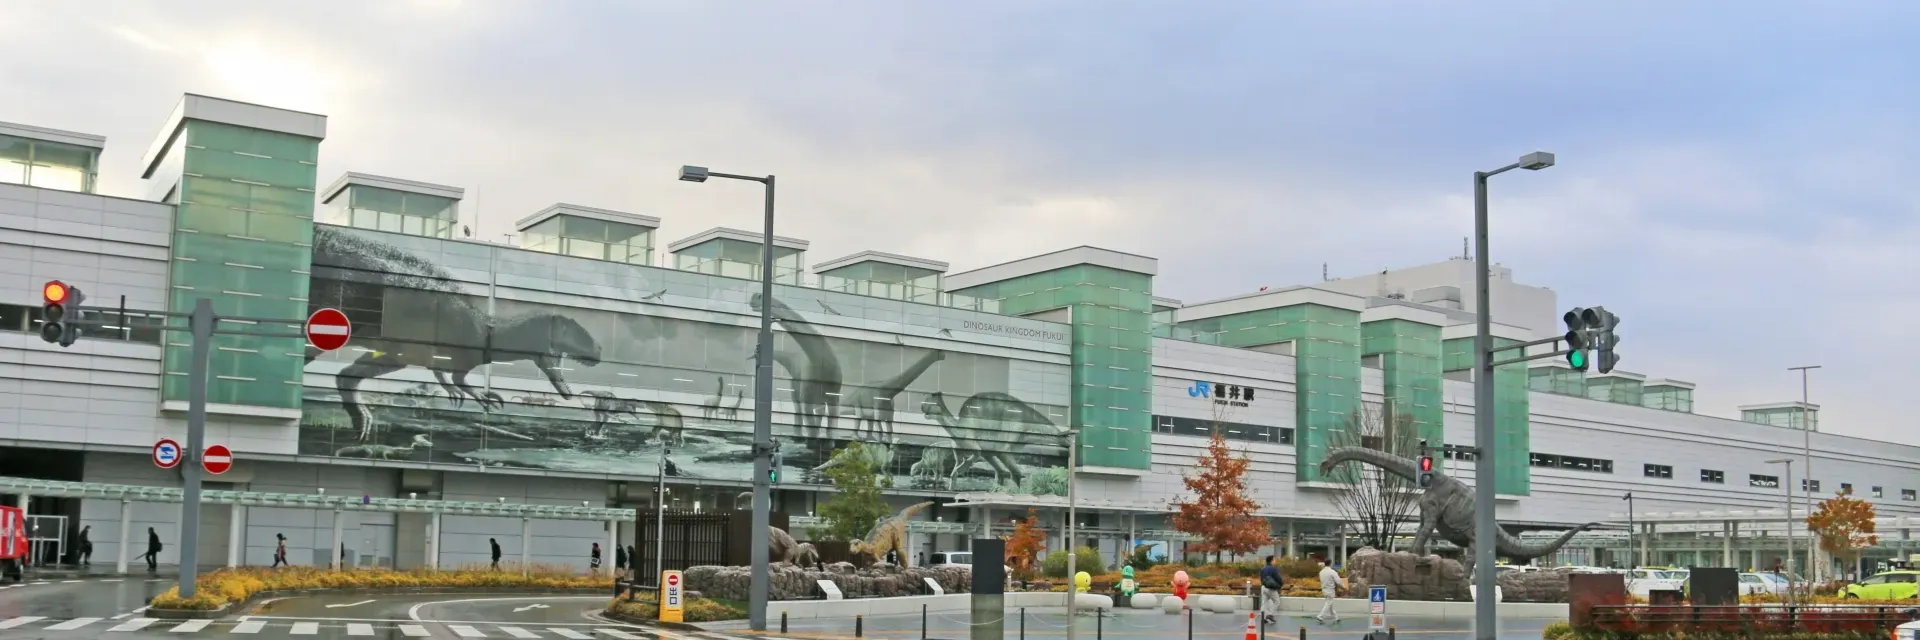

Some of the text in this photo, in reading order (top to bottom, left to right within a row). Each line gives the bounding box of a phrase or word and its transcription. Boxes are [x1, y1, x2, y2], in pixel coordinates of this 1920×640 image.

[963, 320, 1064, 341] DINOSAUR KINGDOM FUKUI
[1188, 380, 1210, 398] JR
[669, 587, 678, 605] 出口
